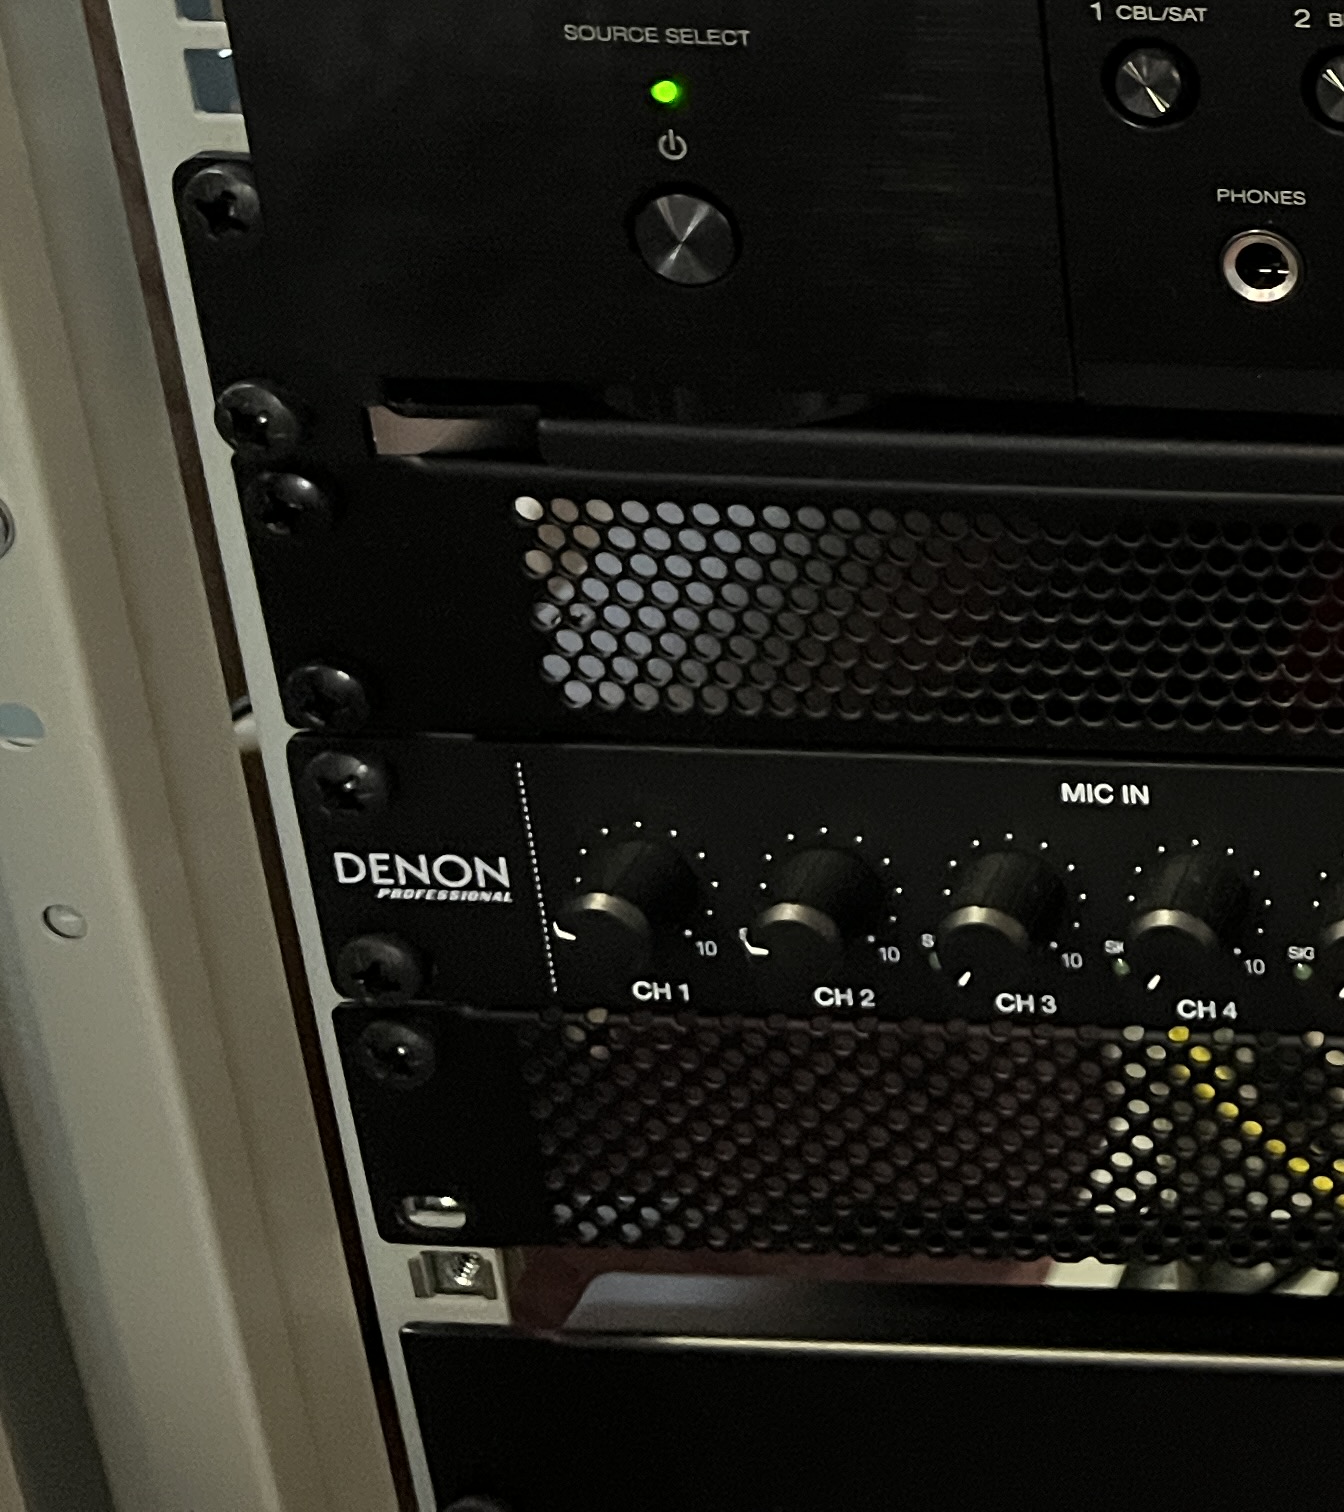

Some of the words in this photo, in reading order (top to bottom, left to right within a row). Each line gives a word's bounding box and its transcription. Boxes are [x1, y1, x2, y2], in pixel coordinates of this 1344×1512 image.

[1091, 2, 1103, 22] 1
[1116, 5, 1208, 23] CBL/SAT
[1294, 9, 1311, 29] 2
[564, 24, 659, 43] SOURCE
[665, 28, 750, 46] SELECT
[1217, 188, 1306, 206] PHONES
[1061, 783, 1113, 805] MIC
[1121, 785, 1150, 806] IN
[333, 851, 510, 888] DENON
[375, 889, 513, 903] PROFESSIONAL
[695, 940, 718, 956] 10
[1244, 957, 1266, 975] 10
[632, 980, 672, 1001] CH
[678, 983, 689, 1001] 1
[995, 992, 1035, 1014] CH
[1041, 994, 1058, 1015] 3
[1177, 999, 1217, 1020] CH
[1222, 1001, 1237, 1020] 4
